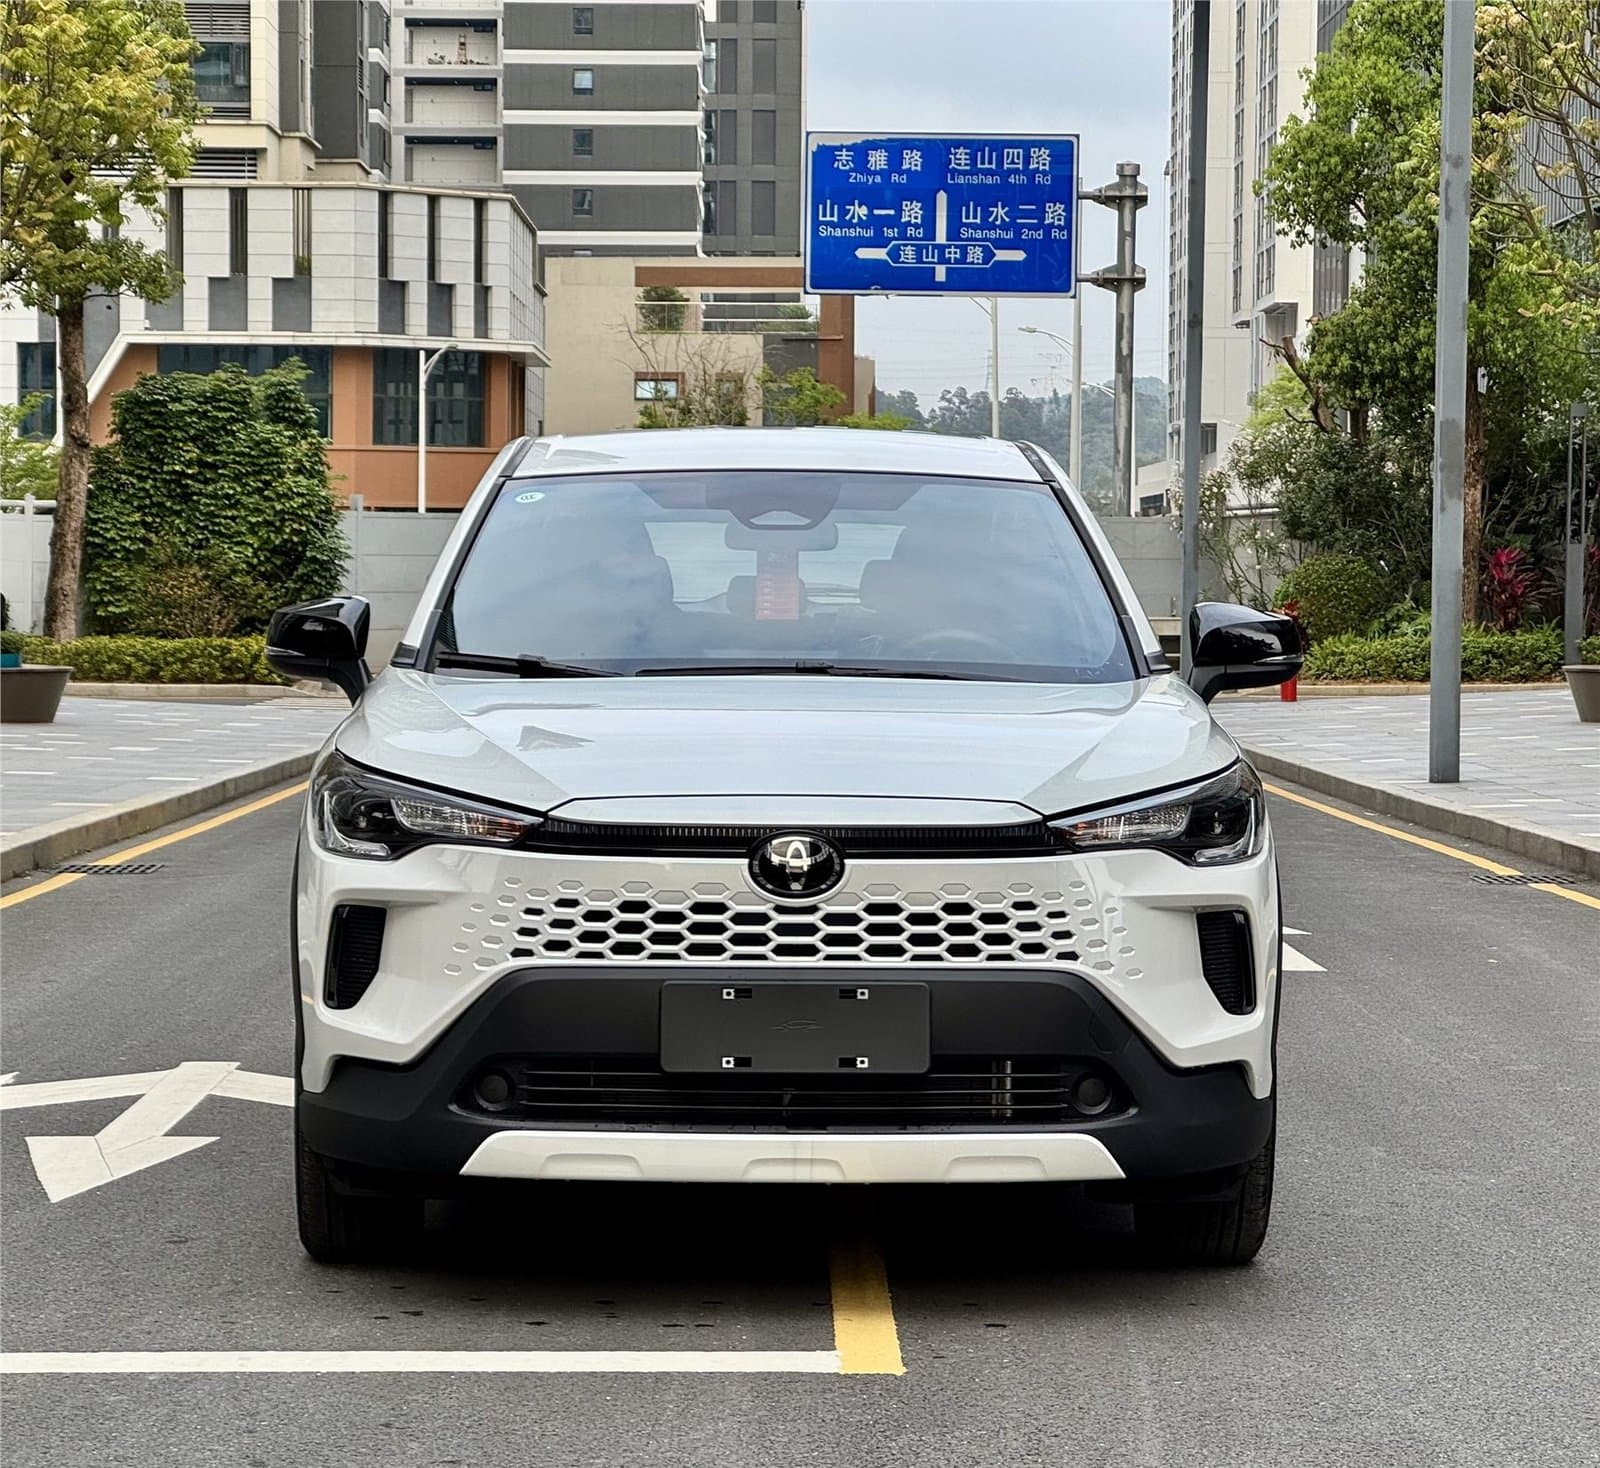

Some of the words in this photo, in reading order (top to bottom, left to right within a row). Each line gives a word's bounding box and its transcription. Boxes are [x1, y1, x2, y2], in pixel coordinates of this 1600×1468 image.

[833, 148, 922, 171] 志雅路
[949, 146, 1051, 171] 连山四路
[848, 172, 882, 184] Zhiya
[891, 173, 907, 183] Rd
[947, 172, 1000, 184] Lianshan
[1008, 173, 1027, 184] 4th
[1035, 174, 1051, 184] Rd
[818, 200, 923, 224] 山水一路
[962, 201, 1066, 226] 山水二路
[819, 226, 873, 237] Shanshui
[883, 227, 898, 237] 1st
[907, 227, 924, 237] Rd
[960, 227, 1014, 239] Shanshui
[1021, 228, 1043, 239] 2nd
[1051, 228, 1067, 239] Rd
[899, 245, 984, 263] 连山中路
